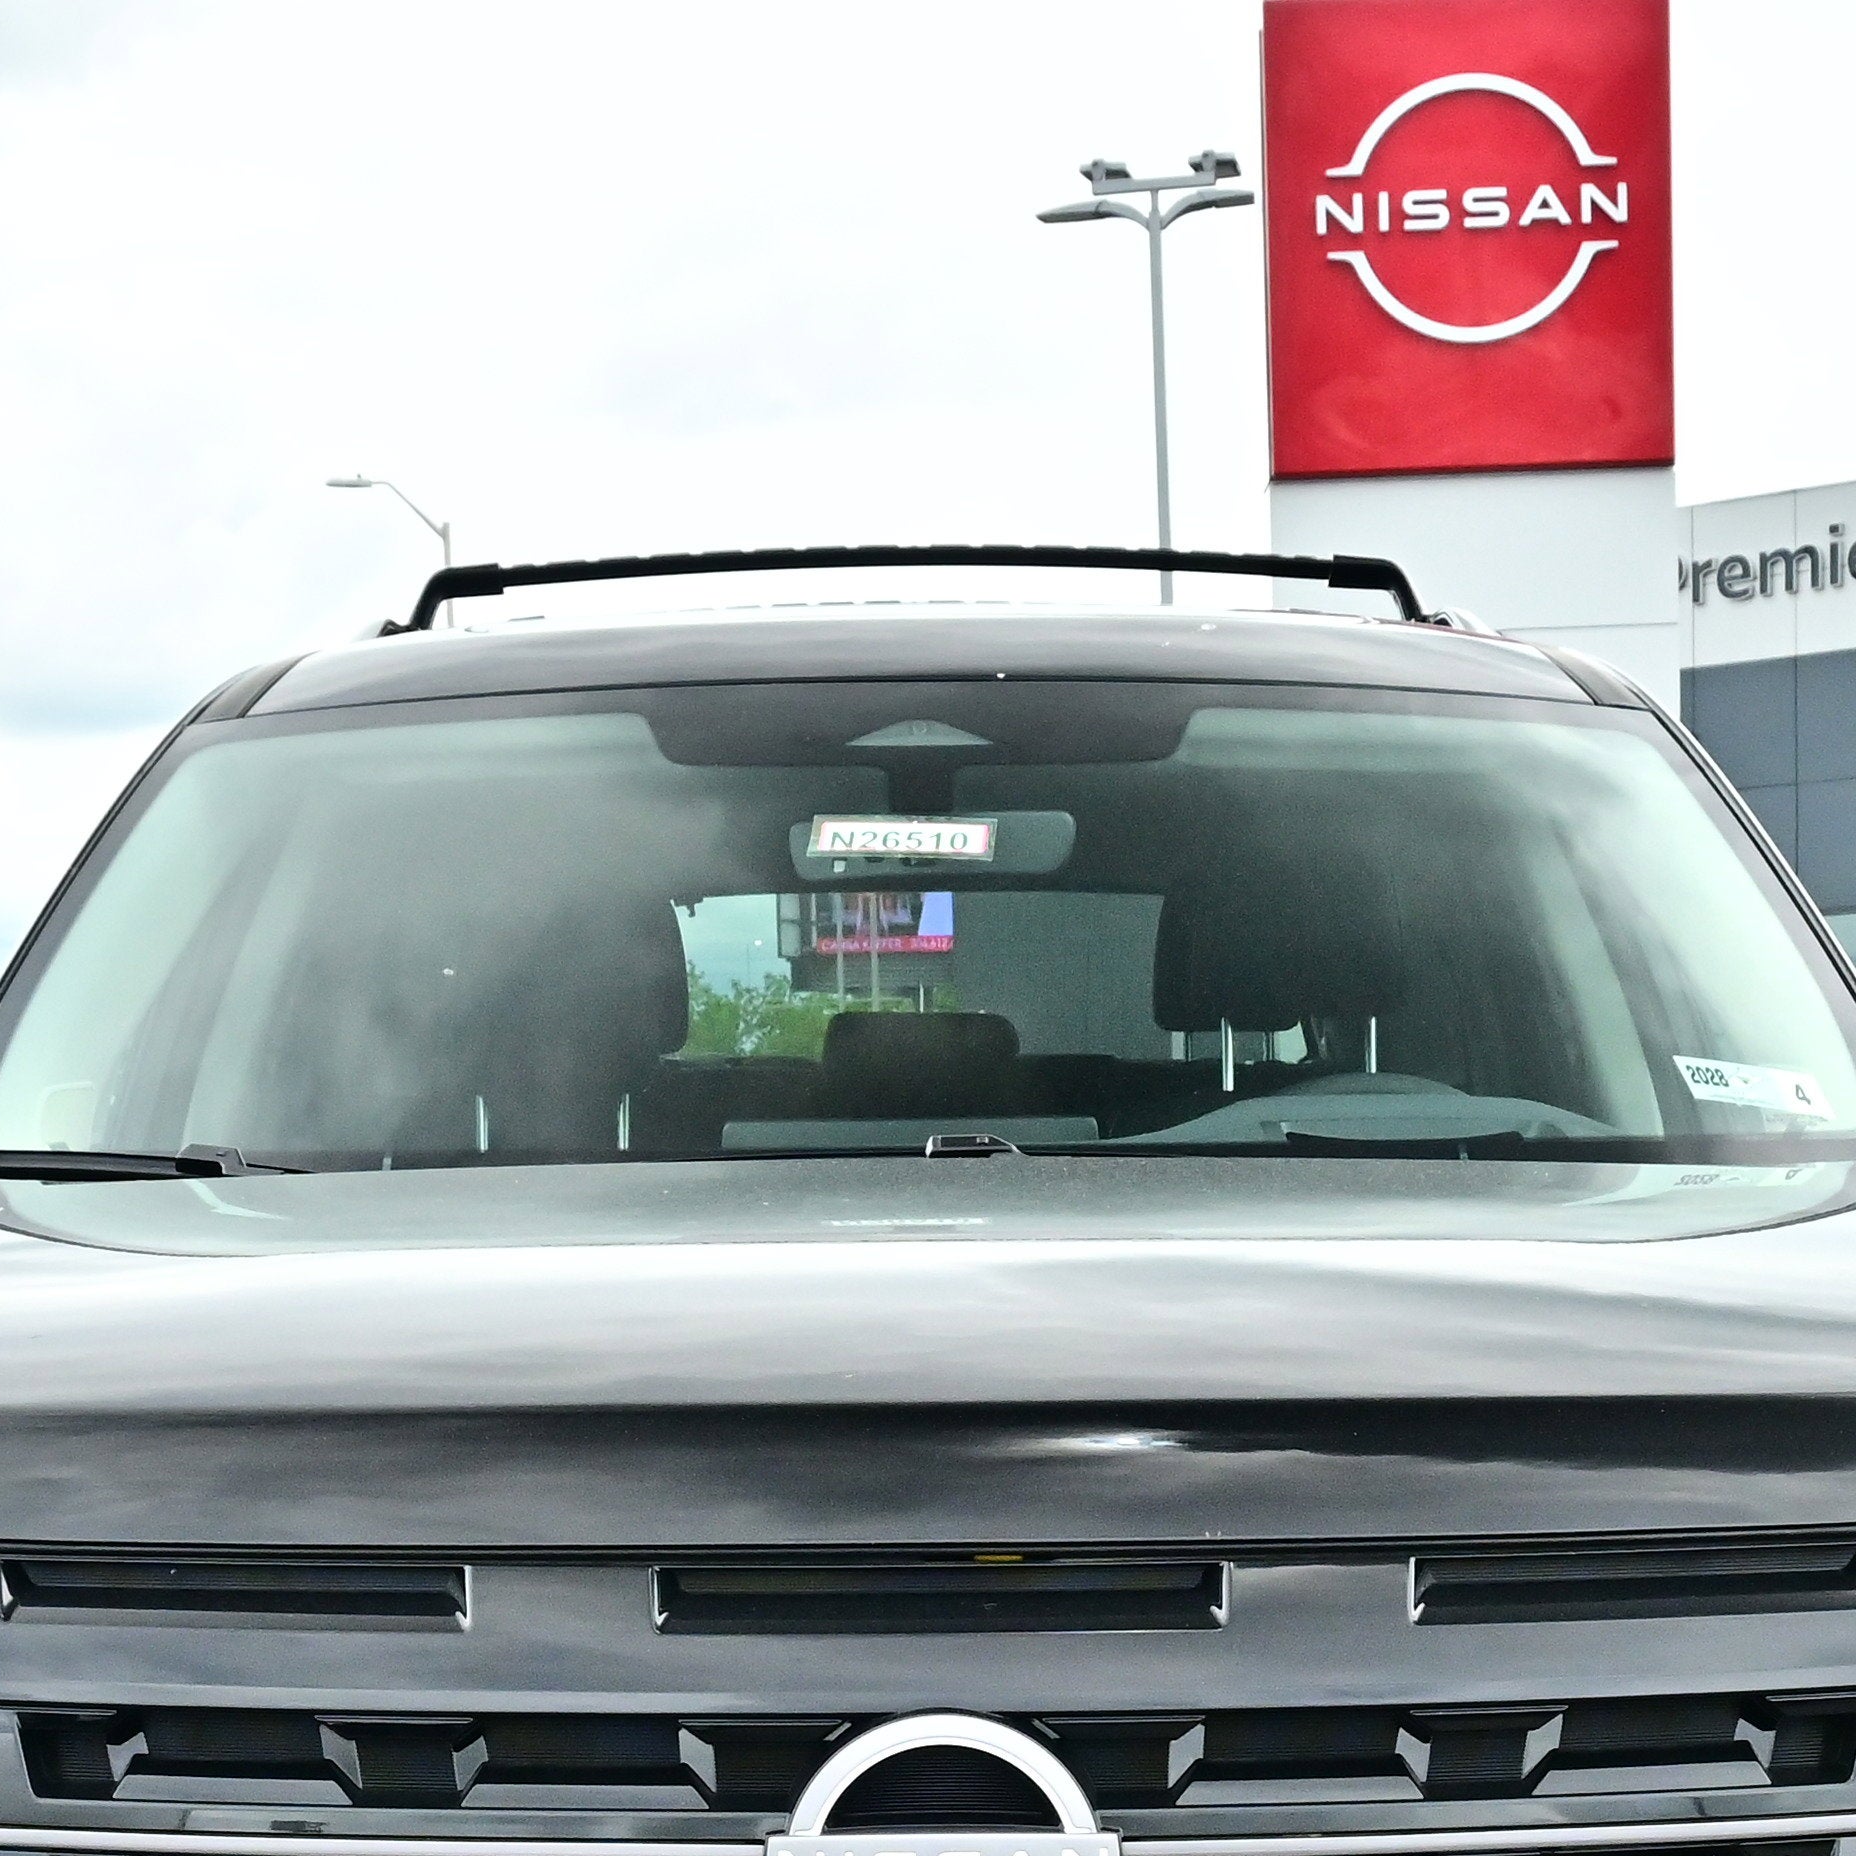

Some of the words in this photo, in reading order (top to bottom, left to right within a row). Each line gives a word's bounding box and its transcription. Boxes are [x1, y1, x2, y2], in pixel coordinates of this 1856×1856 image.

[1315, 181, 1629, 236] NISSAN
[829, 830, 969, 850] N26510
[1685, 1064, 1730, 1088] 2028
